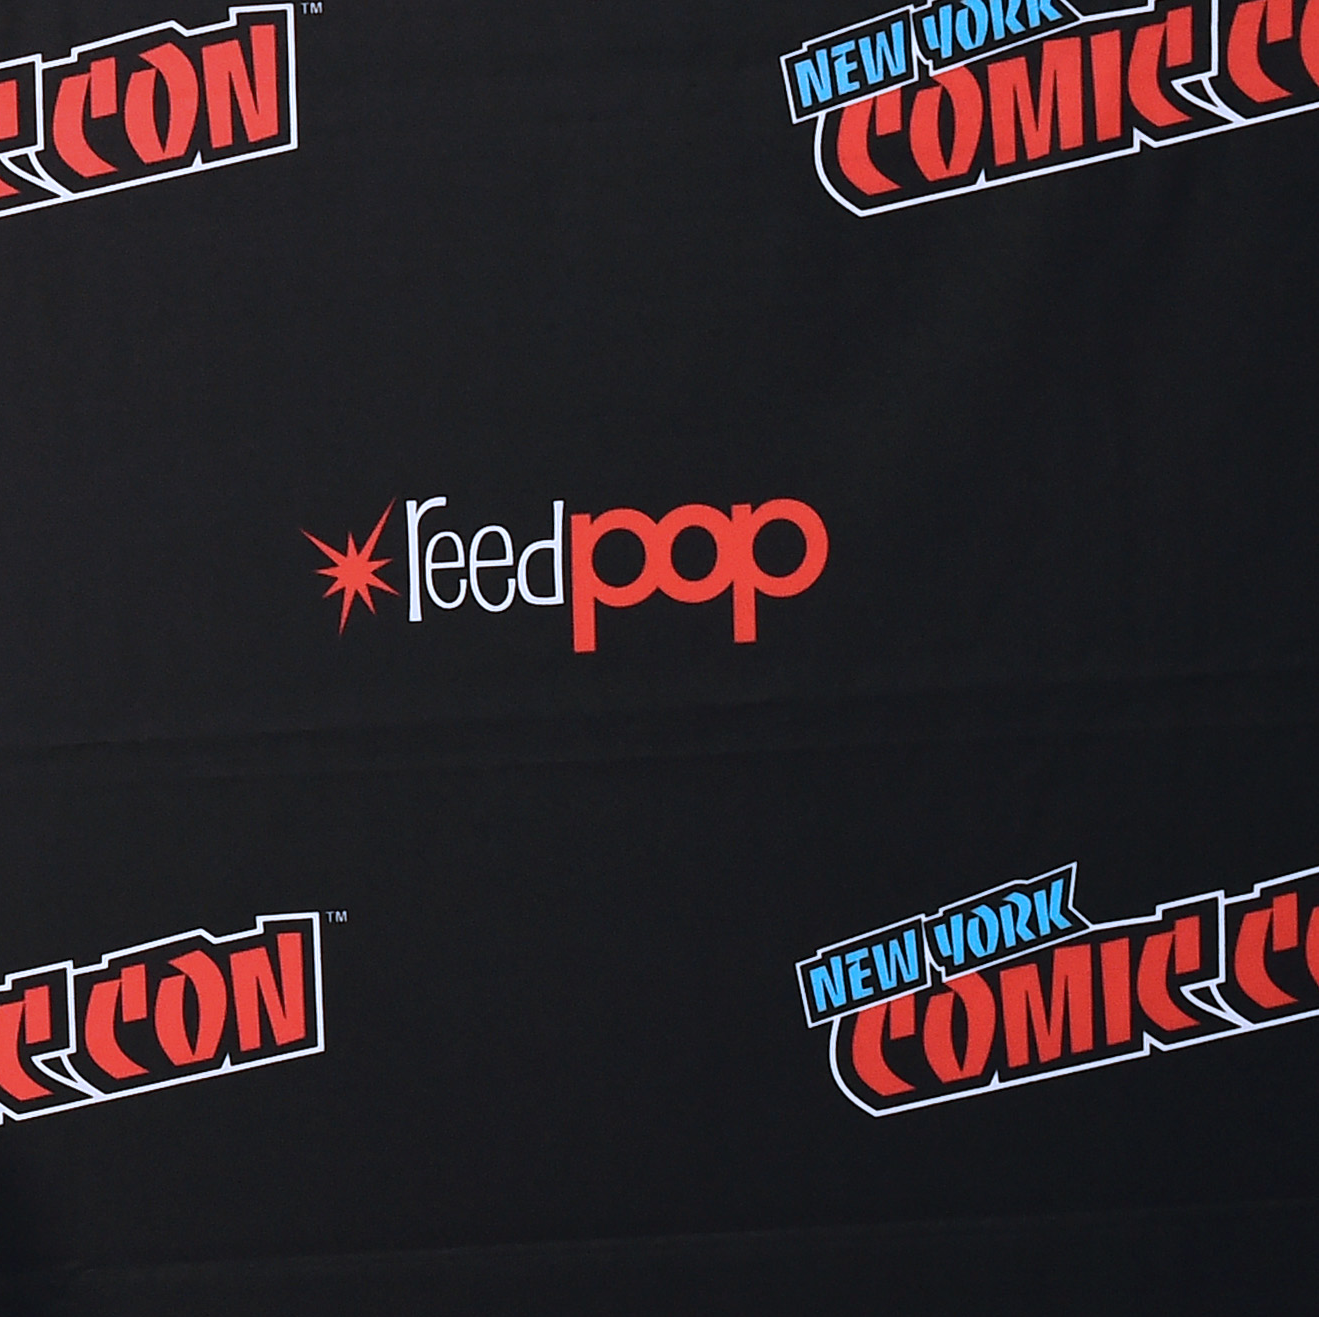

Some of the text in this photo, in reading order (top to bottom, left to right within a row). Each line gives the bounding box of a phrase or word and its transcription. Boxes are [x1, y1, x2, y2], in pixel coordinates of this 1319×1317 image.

[53, 23, 279, 179] CON
[794, 20, 907, 108] NEW
[836, 5, 1193, 196] COMIC
[84, 932, 306, 1080] CON
[809, 878, 1072, 1013] NEW YORK
[852, 915, 1202, 1097] COMIC
